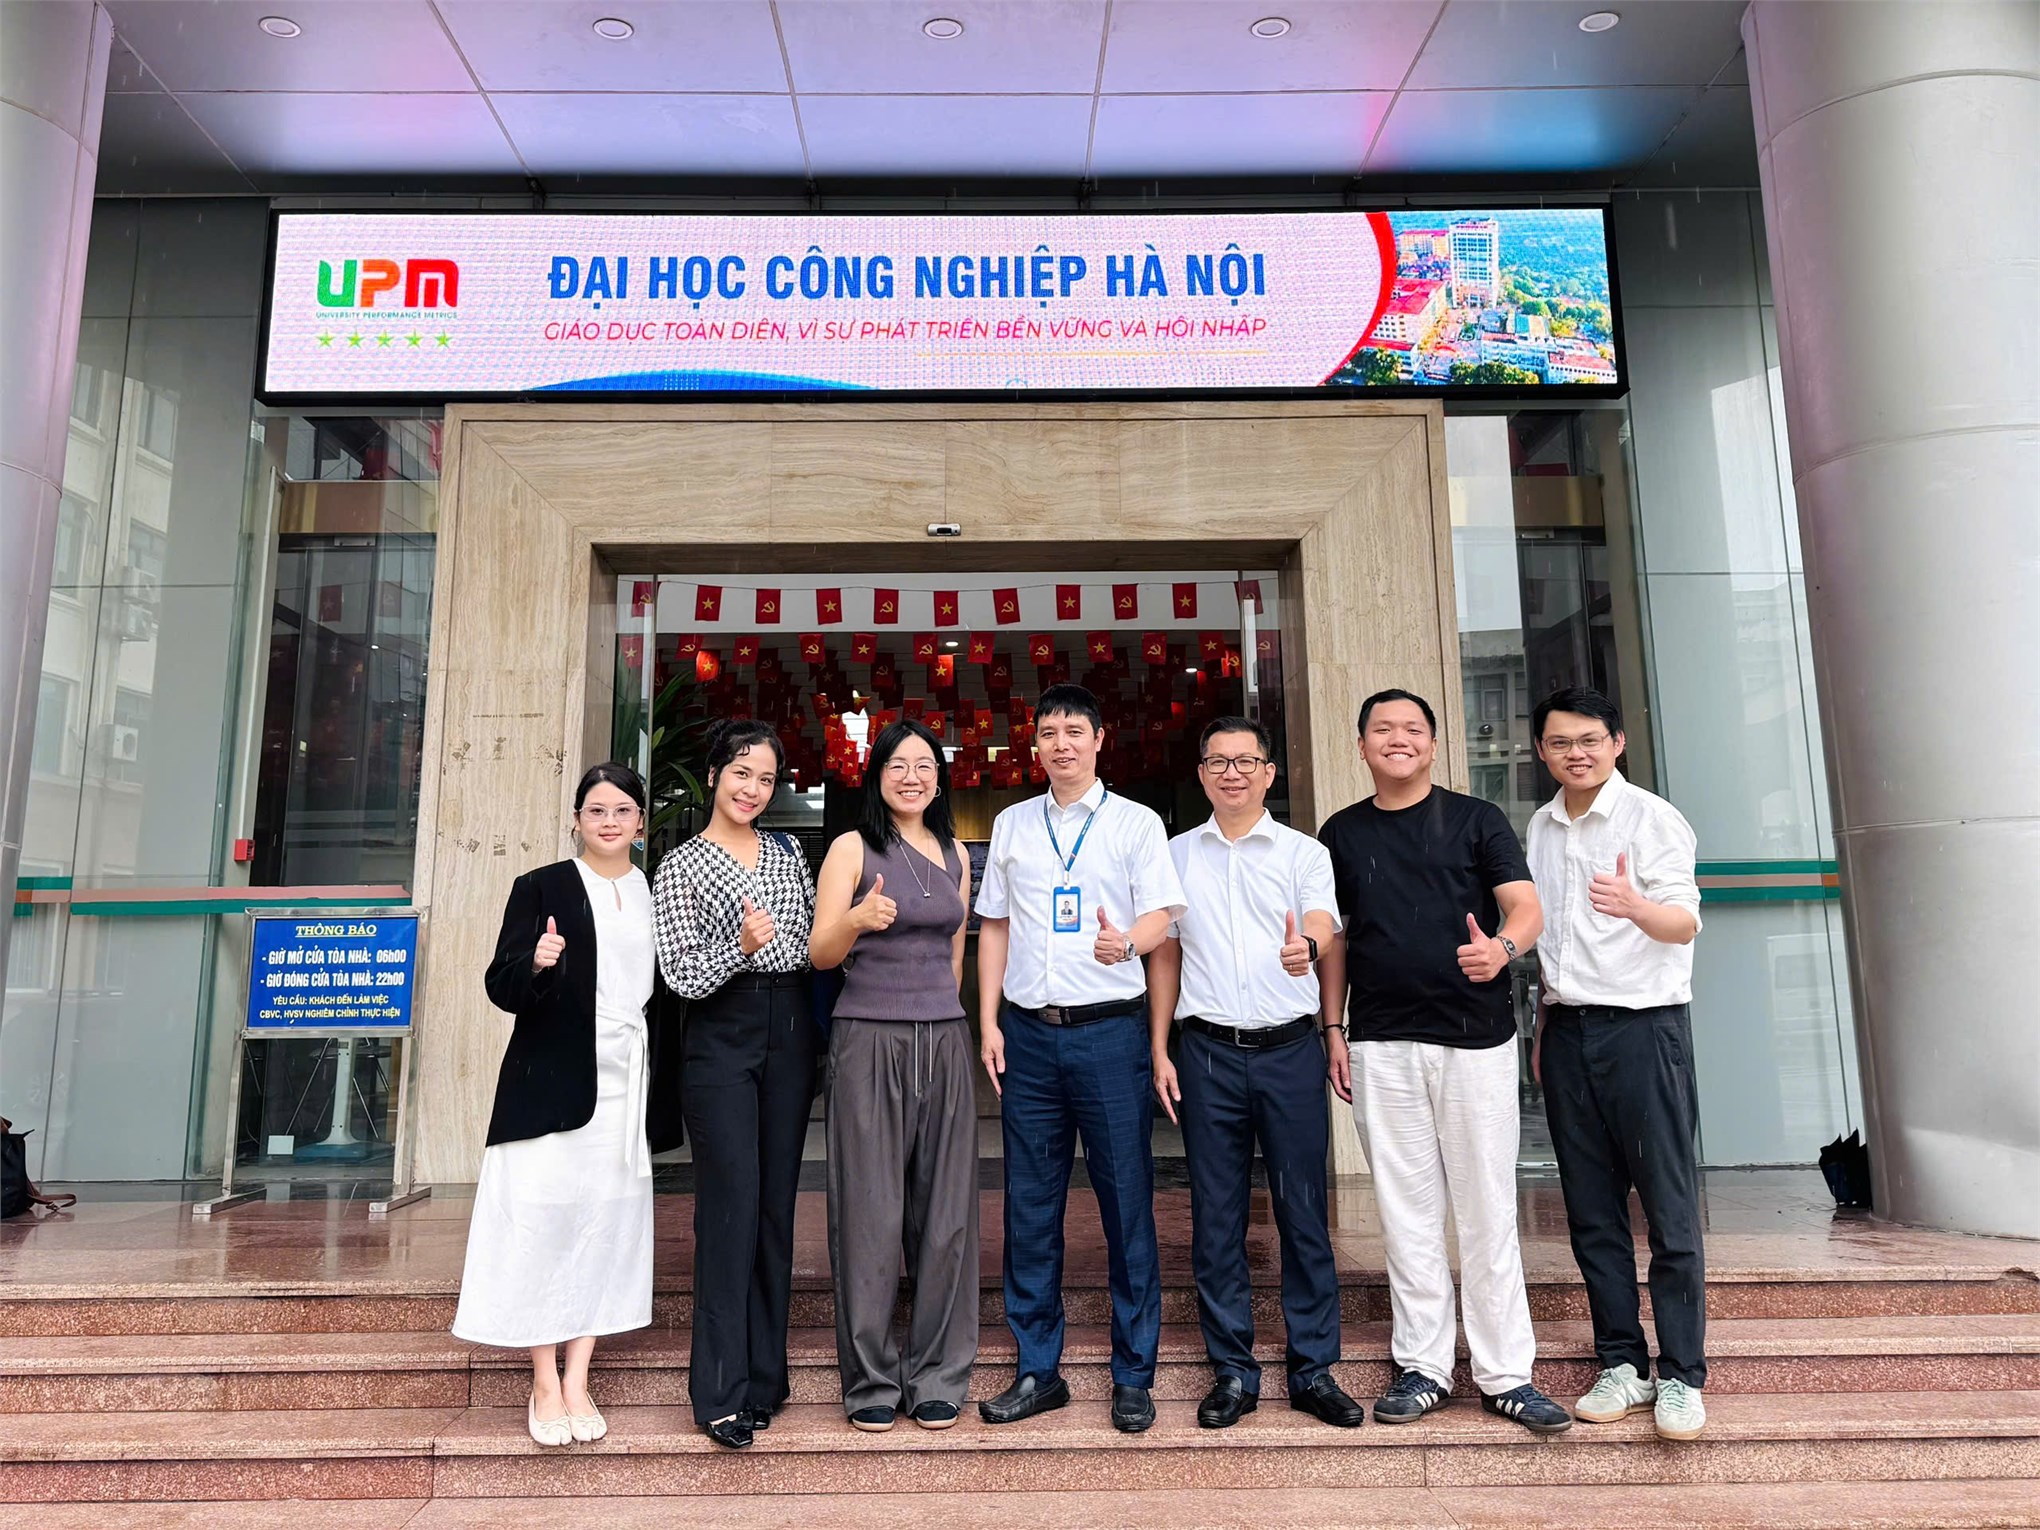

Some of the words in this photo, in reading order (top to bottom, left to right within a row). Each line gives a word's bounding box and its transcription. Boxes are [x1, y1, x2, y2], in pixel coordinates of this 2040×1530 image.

[548, 256, 629, 310] ĐẠI
[649, 256, 746, 310] HỌC
[766, 245, 894, 300] CÔNG
[915, 244, 1087, 308] NGHIỆP
[1106, 243, 1168, 297] HÀ
[1187, 243, 1265, 306] NỘI
[545, 319, 600, 340] GIÁO
[606, 322, 656, 345] DỤC
[664, 319, 724, 340] TOÀN
[799, 318, 818, 339] VÌ
[860, 317, 919, 340] PHÁT
[1050, 316, 1112, 338] VỮNG
[1120, 316, 1147, 337] VÀ
[295, 922, 344, 937] THÔNG
[347, 921, 377, 936] BÁO
[268, 947, 286, 965] GIỜ
[287, 945, 303, 964] MỞ
[305, 944, 325, 964] CỬA
[328, 947, 345, 964] TÒA
[348, 947, 371, 964] NHÀ:
[376, 949, 407, 963] 06h00
[266, 970, 283, 988] GIỜ
[284, 971, 309, 987] ĐÓNG
[311, 967, 330, 987] CỬA
[333, 970, 349, 986] TÒA
[351, 969, 374, 986] NHÀ:
[375, 971, 405, 986] 22h00
[272, 994, 288, 1005] YÊU
[308, 993, 336, 1005] KHÁCH
[336, 992, 353, 1004] ĐẾN
[353, 993, 370, 1004] LÀM
[371, 993, 389, 1008] VIỆC
[259, 1010, 283, 1019] CBVC,
[305, 1007, 335, 1018] NGHIÊM
[361, 1007, 381, 1018] THỰC
[382, 1006, 401, 1018] HIỆN
